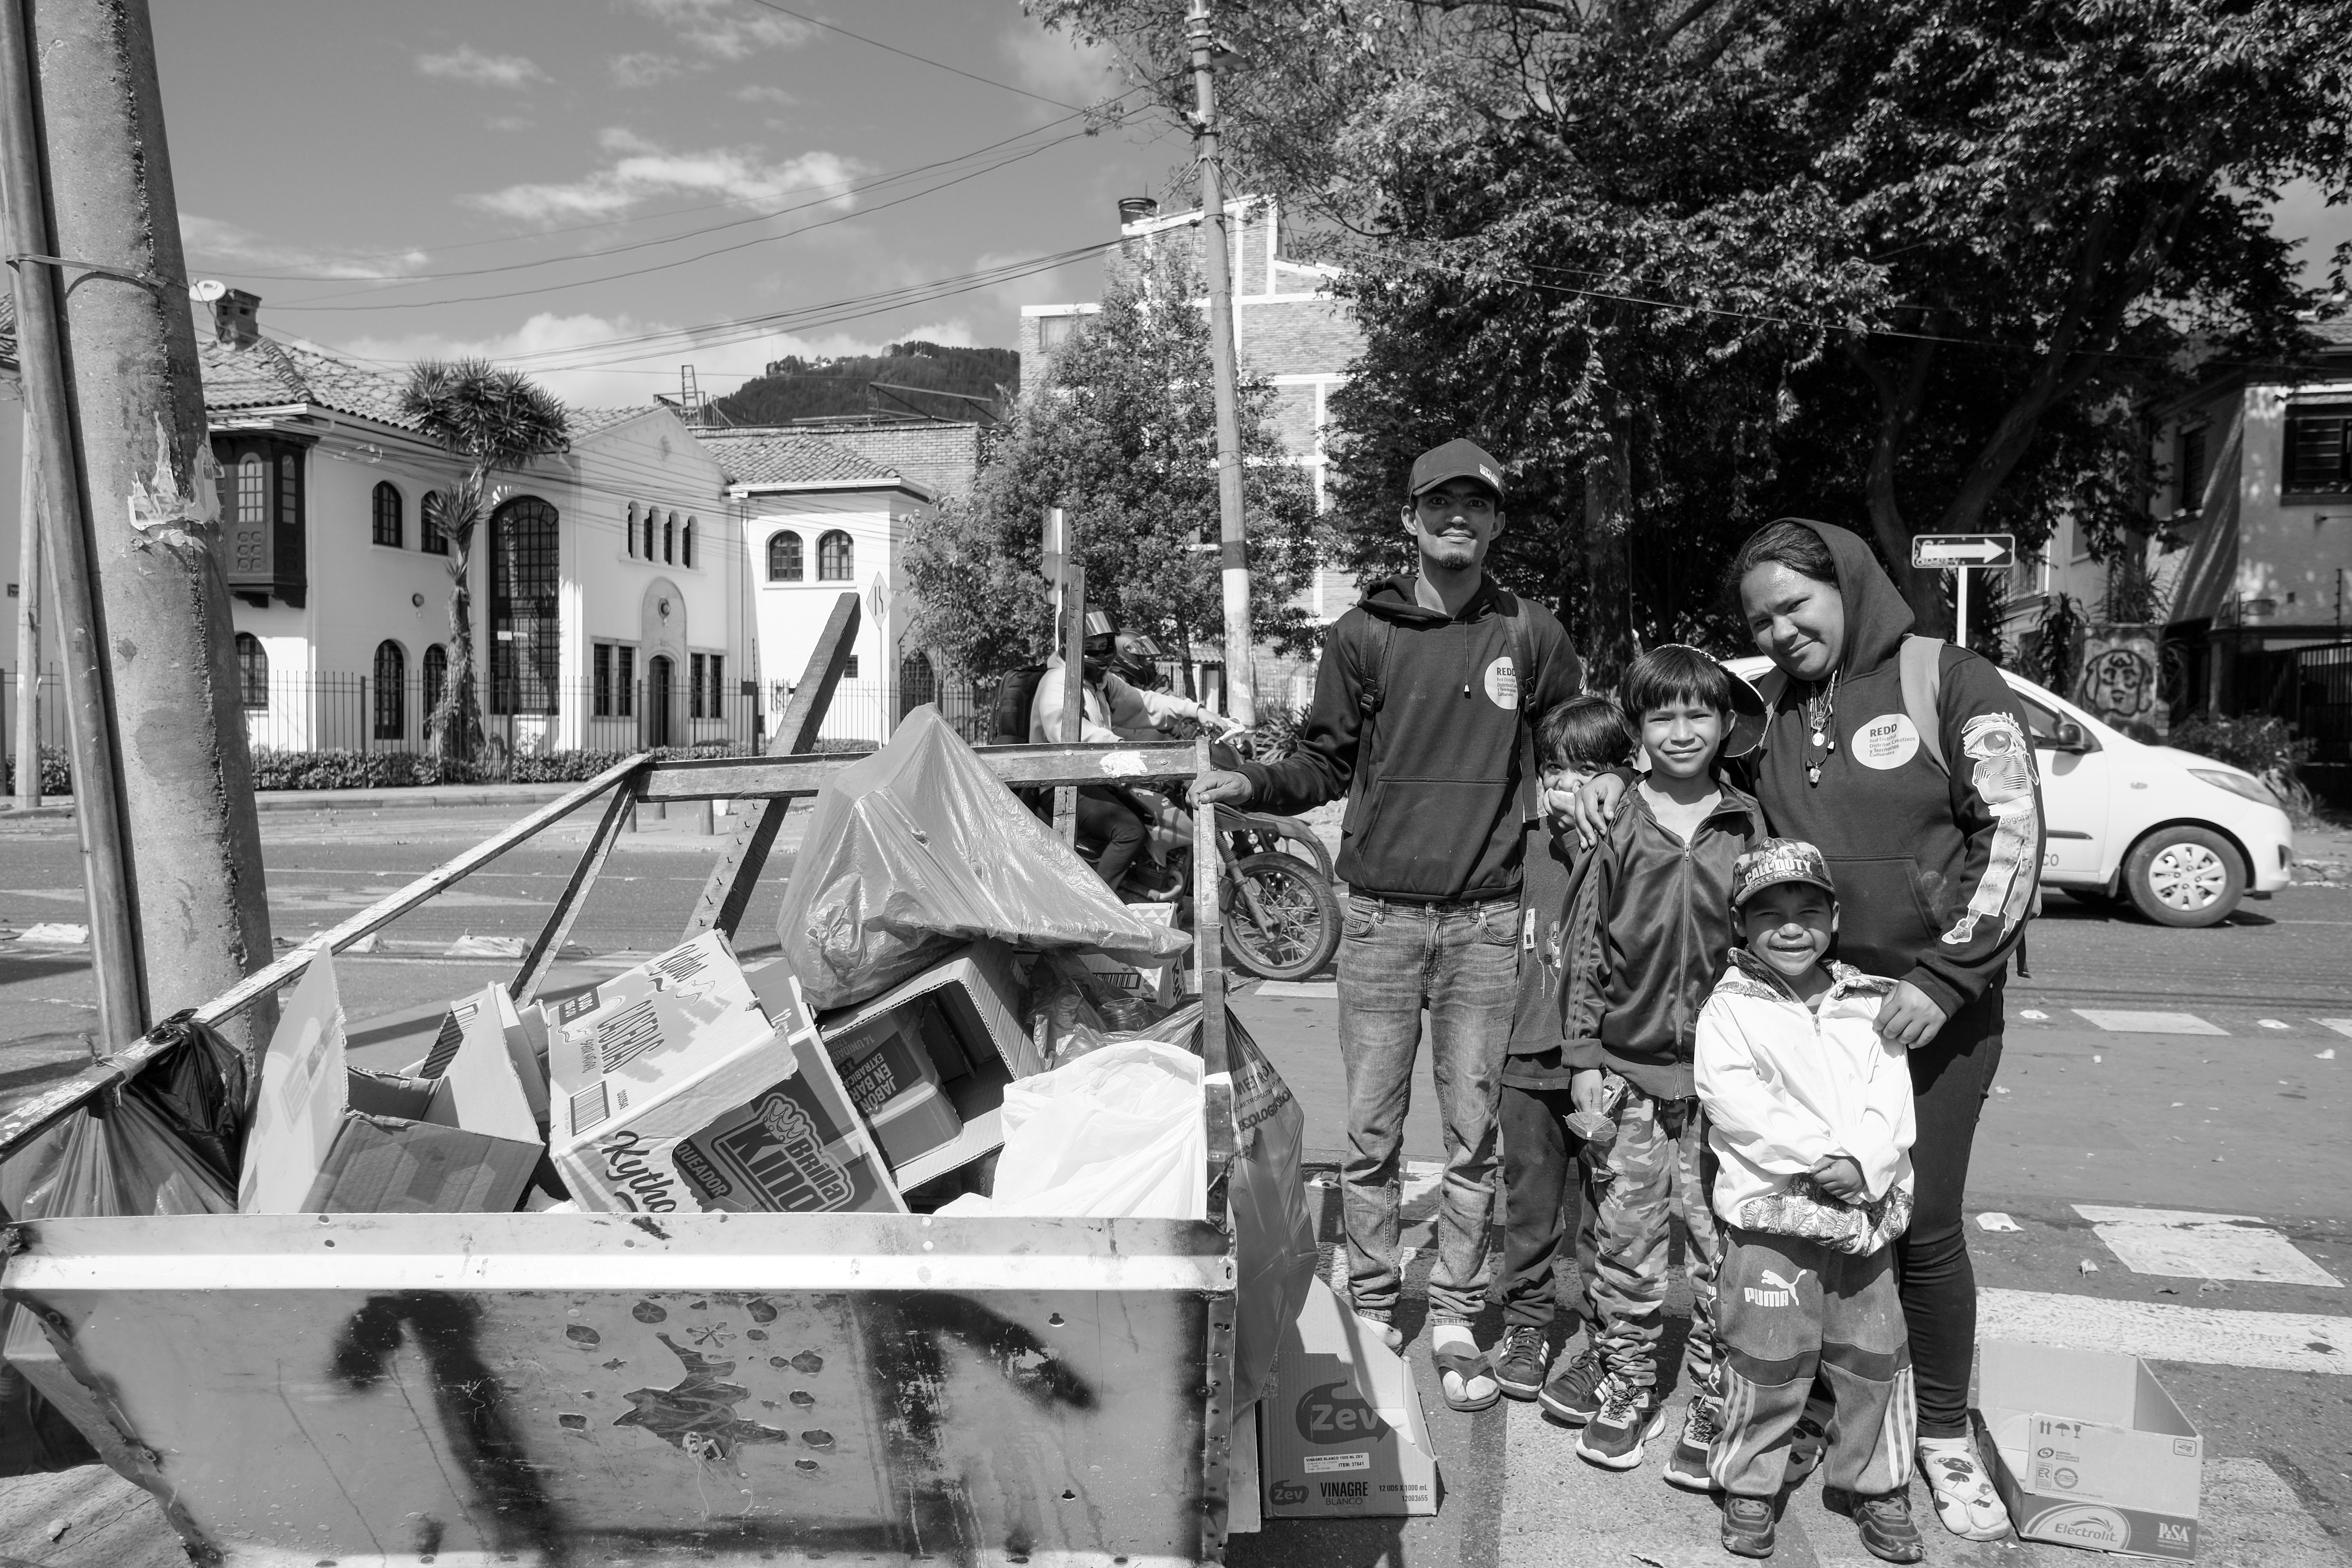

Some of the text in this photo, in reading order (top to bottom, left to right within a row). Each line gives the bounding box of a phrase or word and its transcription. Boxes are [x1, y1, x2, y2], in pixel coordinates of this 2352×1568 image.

[1497, 667, 1516, 676] REDD
[1870, 724, 1897, 737] REDD
[2043, 853, 2059, 866] CO
[1745, 862, 1773, 885] CALL
[1774, 859, 1811, 872] DUTY
[597, 999, 665, 1074] CASERAS
[827, 1038, 847, 1053] 12000
[863, 1034, 875, 1046] 14
[843, 1052, 885, 1089] EXTRABICA
[848, 1062, 856, 1071] X
[848, 1063, 892, 1102] EN BAR
[860, 1076, 897, 1113] JABÓN
[602, 1130, 677, 1212] Kytho
[678, 1139, 729, 1196] QUEADOR
[1744, 1287, 1789, 1307] PUMA
[1312, 1404, 1380, 1430] Zev
[1275, 1489, 1303, 1500] Zev
[1320, 1481, 1368, 1497] VINAGRE
